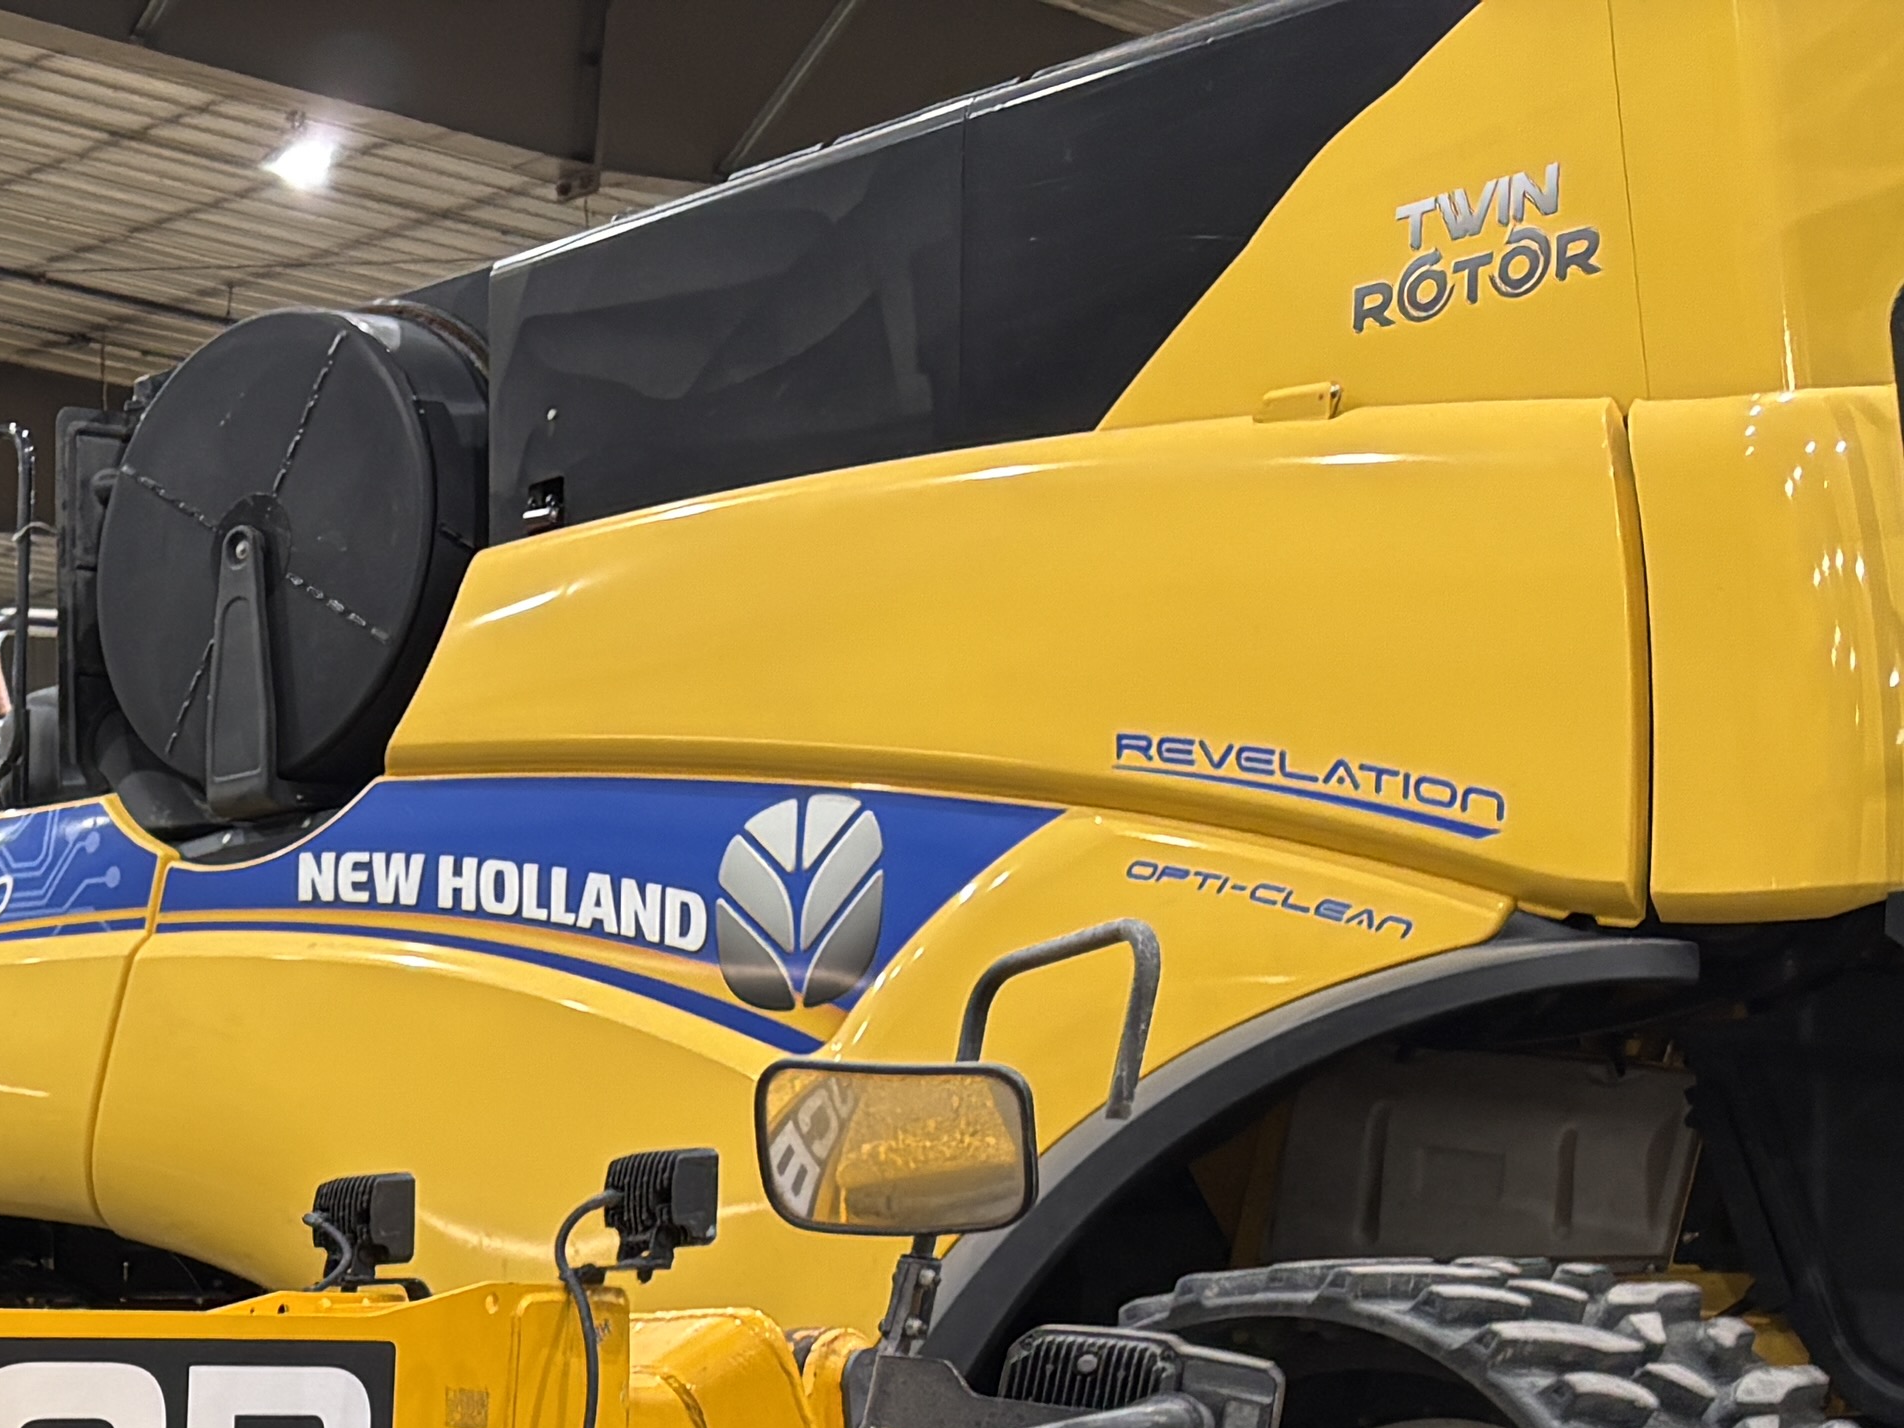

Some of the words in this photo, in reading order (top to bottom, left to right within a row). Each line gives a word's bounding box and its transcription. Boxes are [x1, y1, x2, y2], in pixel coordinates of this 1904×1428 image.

[1395, 161, 1560, 250] TWIN
[1352, 226, 1602, 334] ROTOR
[1115, 732, 1505, 821] REVELATION
[297, 851, 425, 906] NEW
[437, 854, 708, 952] HOLLAND
[1126, 860, 1414, 939] OPTI-CLEAN
